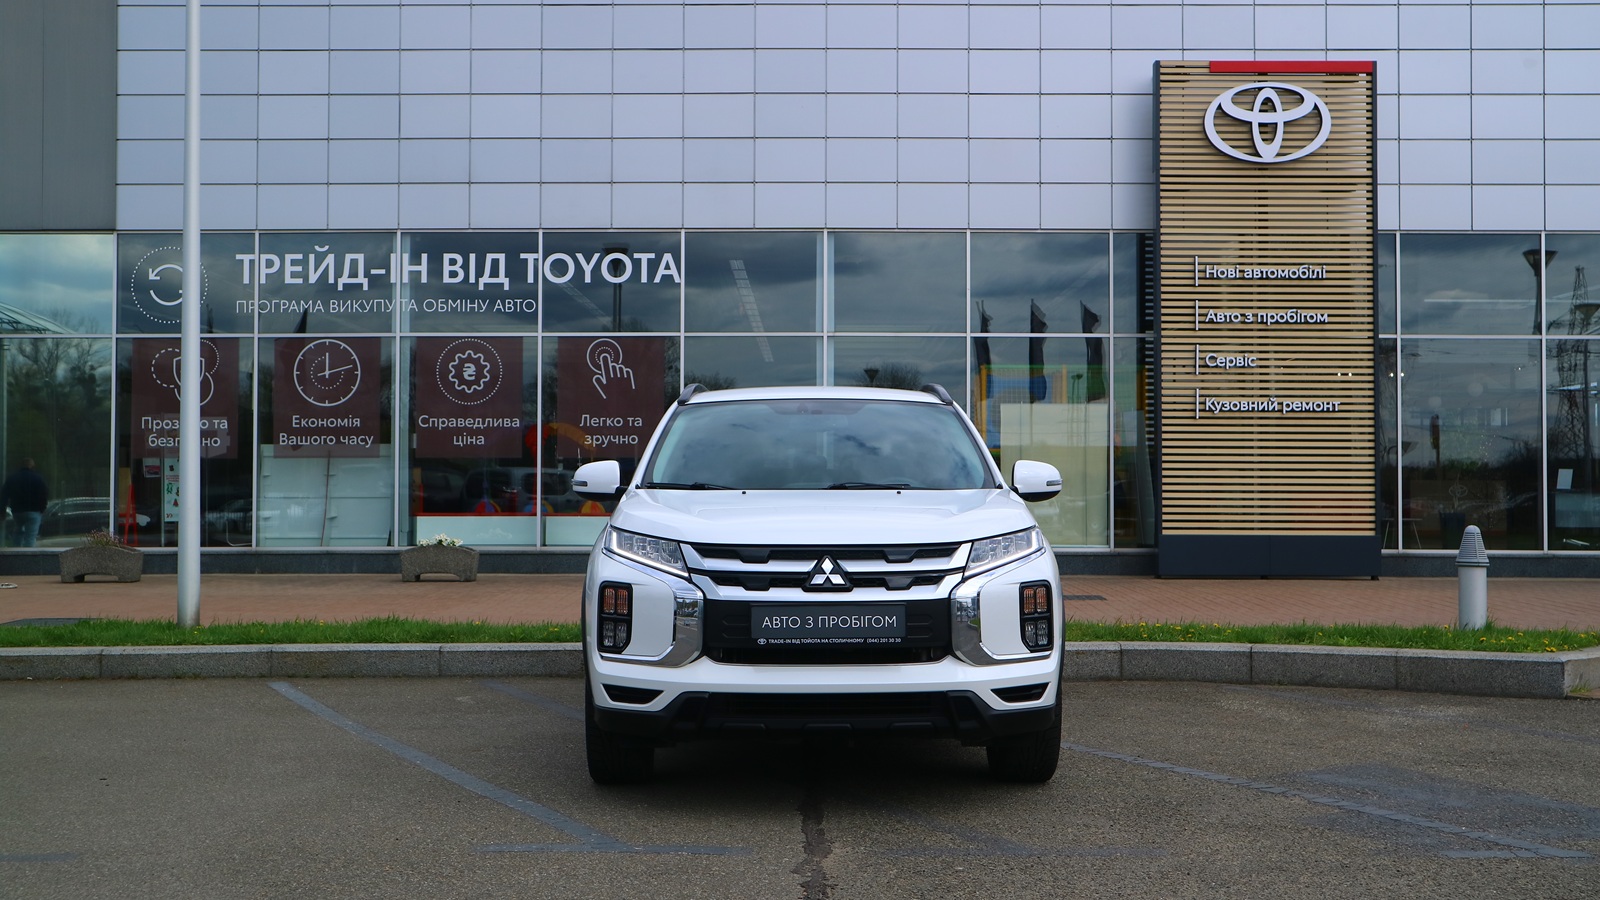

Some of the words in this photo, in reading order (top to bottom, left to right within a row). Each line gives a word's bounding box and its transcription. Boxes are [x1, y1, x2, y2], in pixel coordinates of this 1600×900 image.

[235, 245, 428, 291] ТРЕЙД-ІН
[442, 252, 510, 291] ВІД
[519, 252, 682, 284] TOYOTA
[1205, 264, 1240, 279] Нові
[1243, 264, 1327, 279] автомобілі
[236, 300, 325, 314] ПРОГРАМА
[329, 300, 395, 313] ВИКУПУ
[398, 299, 419, 312] ТА
[423, 299, 490, 313] ОБМІНУ
[493, 299, 536, 313] АВТО
[1205, 309, 1241, 323] Авто
[1244, 312, 1254, 323] з
[1257, 309, 1329, 326] пробігом
[1205, 353, 1257, 370] Сервіс
[1205, 397, 1279, 415] Кузовний
[1282, 401, 1341, 415] ремонт
[141, 416, 209, 432] Прозо
[213, 419, 229, 430] та
[292, 415, 361, 428] Економія
[418, 414, 520, 429] Справедлива
[579, 414, 624, 428] Легко
[627, 416, 643, 427] та
[279, 432, 336, 446] Вашого
[340, 434, 374, 448] часу
[453, 432, 485, 446] ціна
[584, 434, 639, 449] зручно
[761, 616, 801, 629] АВТО
[805, 615, 814, 629] З
[818, 615, 897, 628] ПРОБІГОМ
